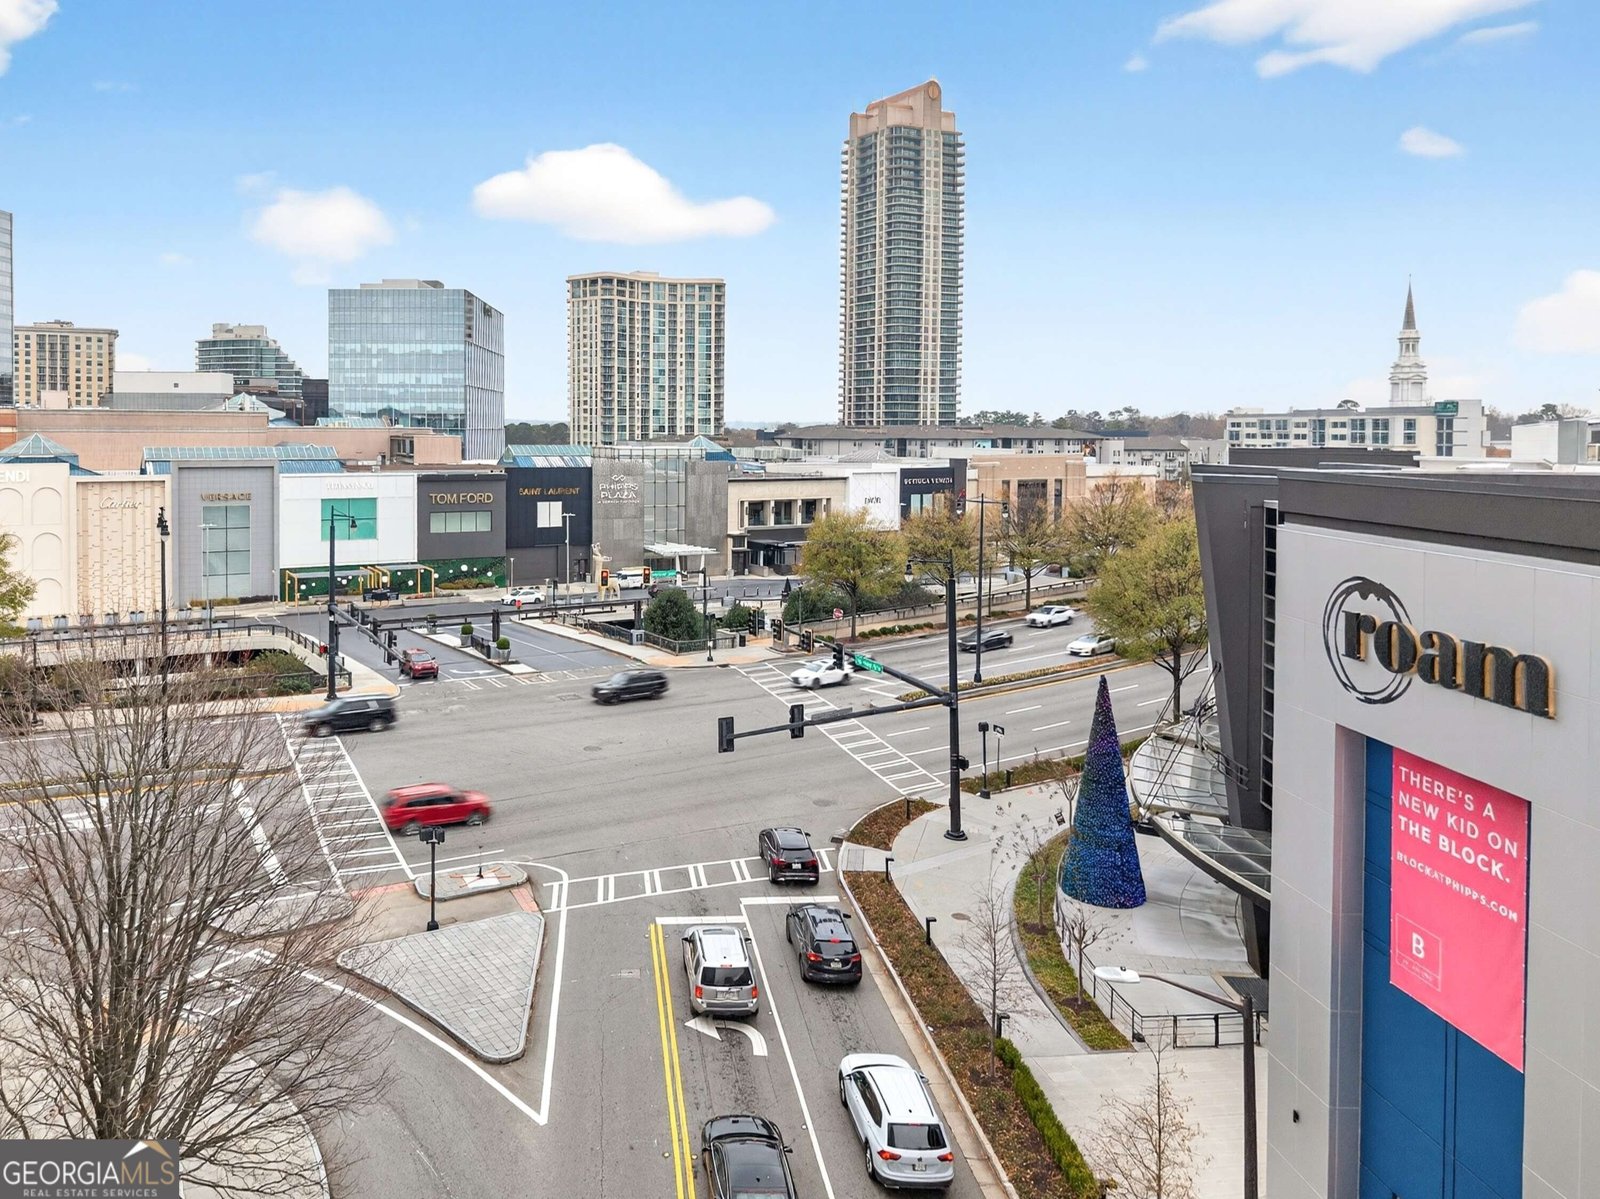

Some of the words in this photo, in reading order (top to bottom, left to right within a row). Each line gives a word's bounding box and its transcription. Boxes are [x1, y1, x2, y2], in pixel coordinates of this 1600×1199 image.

[99, 496, 142, 510] Cartier
[200, 492, 252, 501] VERSACE
[429, 493, 458, 504] TOM
[459, 492, 494, 504] FORD
[519, 487, 541, 496] SAINT
[544, 487, 580, 495] LAURENT
[600, 490, 637, 499] PLAZA
[1341, 609, 1557, 720] roam
[1398, 766, 1475, 811] THERE'S
[1482, 802, 1496, 822] A
[1398, 790, 1440, 821] NEW
[1446, 812, 1479, 840] KID
[1487, 831, 1518, 859] ON
[1398, 814, 1432, 845] THE
[1438, 834, 1511, 883] BLOCK.
[1396, 851, 1518, 923] BLOCKATPHIPPS.COM
[1412, 931, 1425, 959] B
